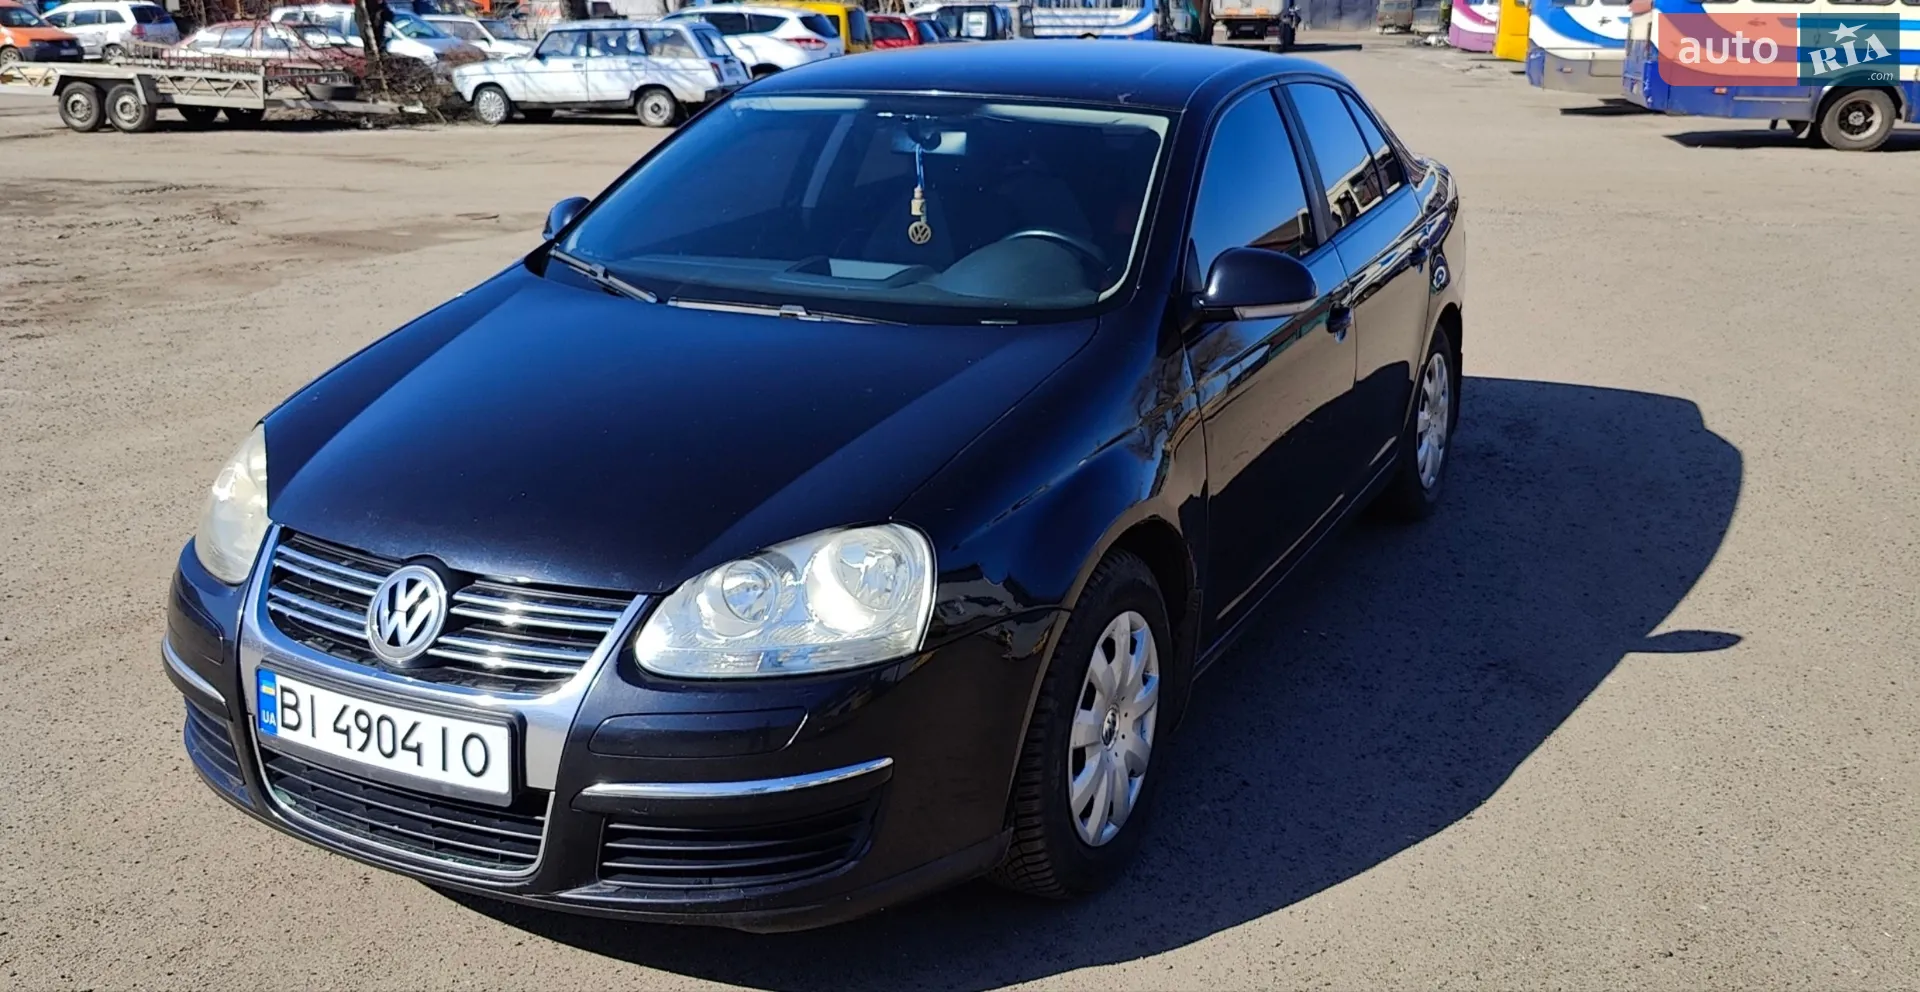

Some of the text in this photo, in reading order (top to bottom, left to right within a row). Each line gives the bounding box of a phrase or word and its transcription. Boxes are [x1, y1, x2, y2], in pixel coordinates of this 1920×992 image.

[370, 571, 443, 656] VW
[262, 709, 277, 726] UA
[280, 684, 489, 778] BI 4904 IO
